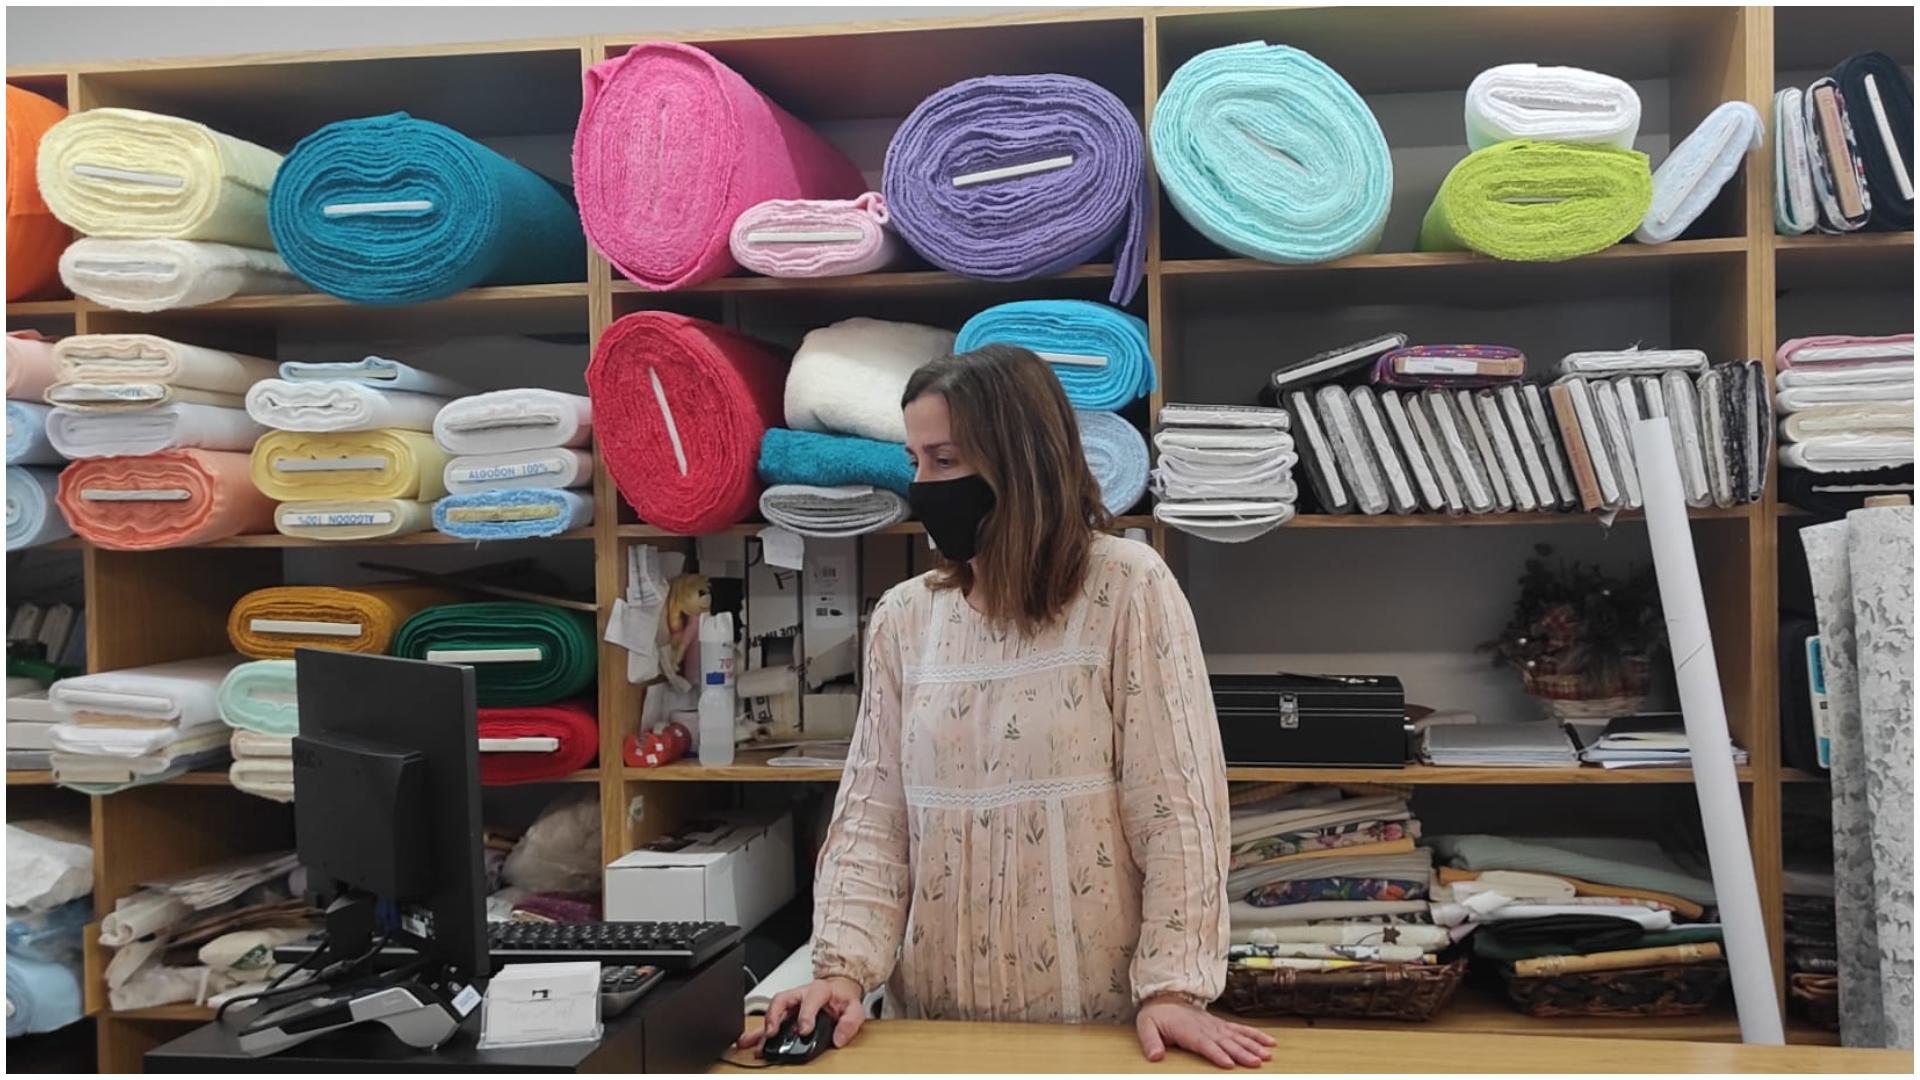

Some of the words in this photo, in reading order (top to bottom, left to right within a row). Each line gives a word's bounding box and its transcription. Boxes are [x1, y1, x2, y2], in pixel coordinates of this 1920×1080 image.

[468, 466, 516, 480] ALGODON
[522, 463, 549, 474] 100%
[298, 515, 322, 526] 100%
[328, 514, 375, 526] ALGODON
